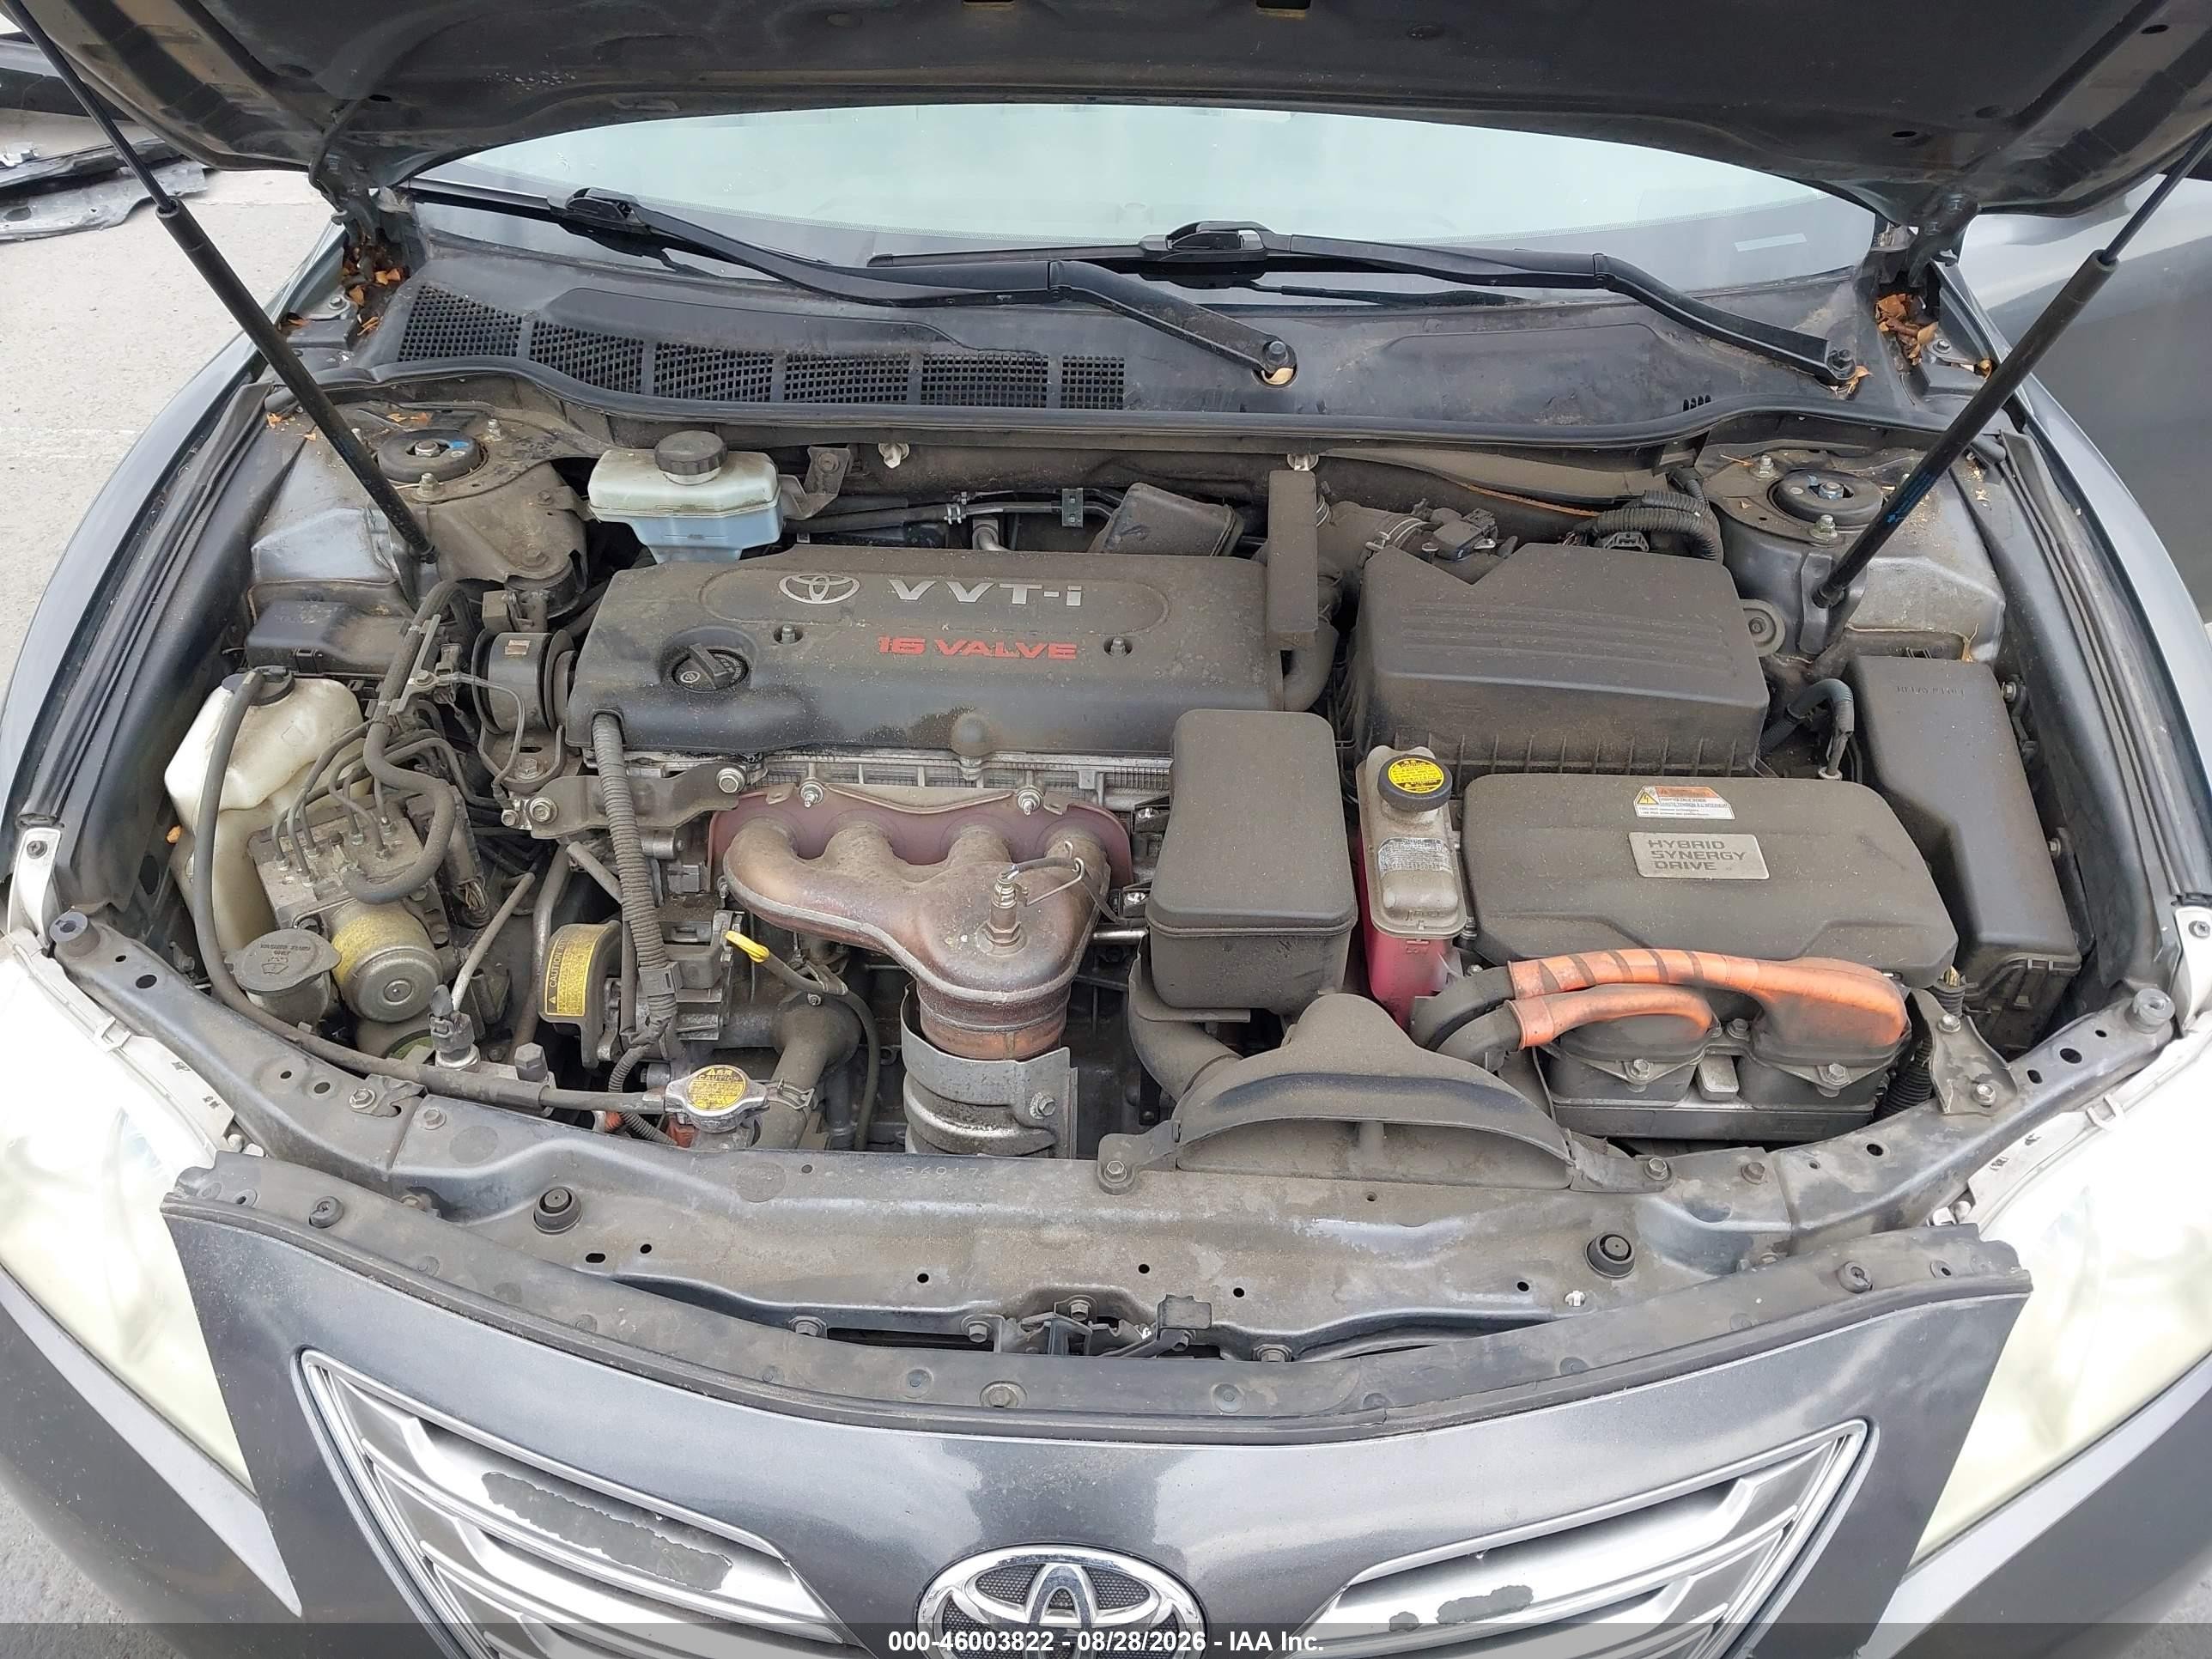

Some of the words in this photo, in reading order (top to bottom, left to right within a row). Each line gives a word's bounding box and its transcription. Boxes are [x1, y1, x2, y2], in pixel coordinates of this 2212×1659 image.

[888, 579, 1083, 606] VVT-i
[878, 635, 927, 655] 16
[934, 638, 1078, 659] VALVE
[1648, 839, 1726, 849] HYBRID
[1650, 850, 1747, 860] SYNERGY
[1654, 861, 1717, 871] DRIVE
[550, 951, 563, 988] CAUTION
